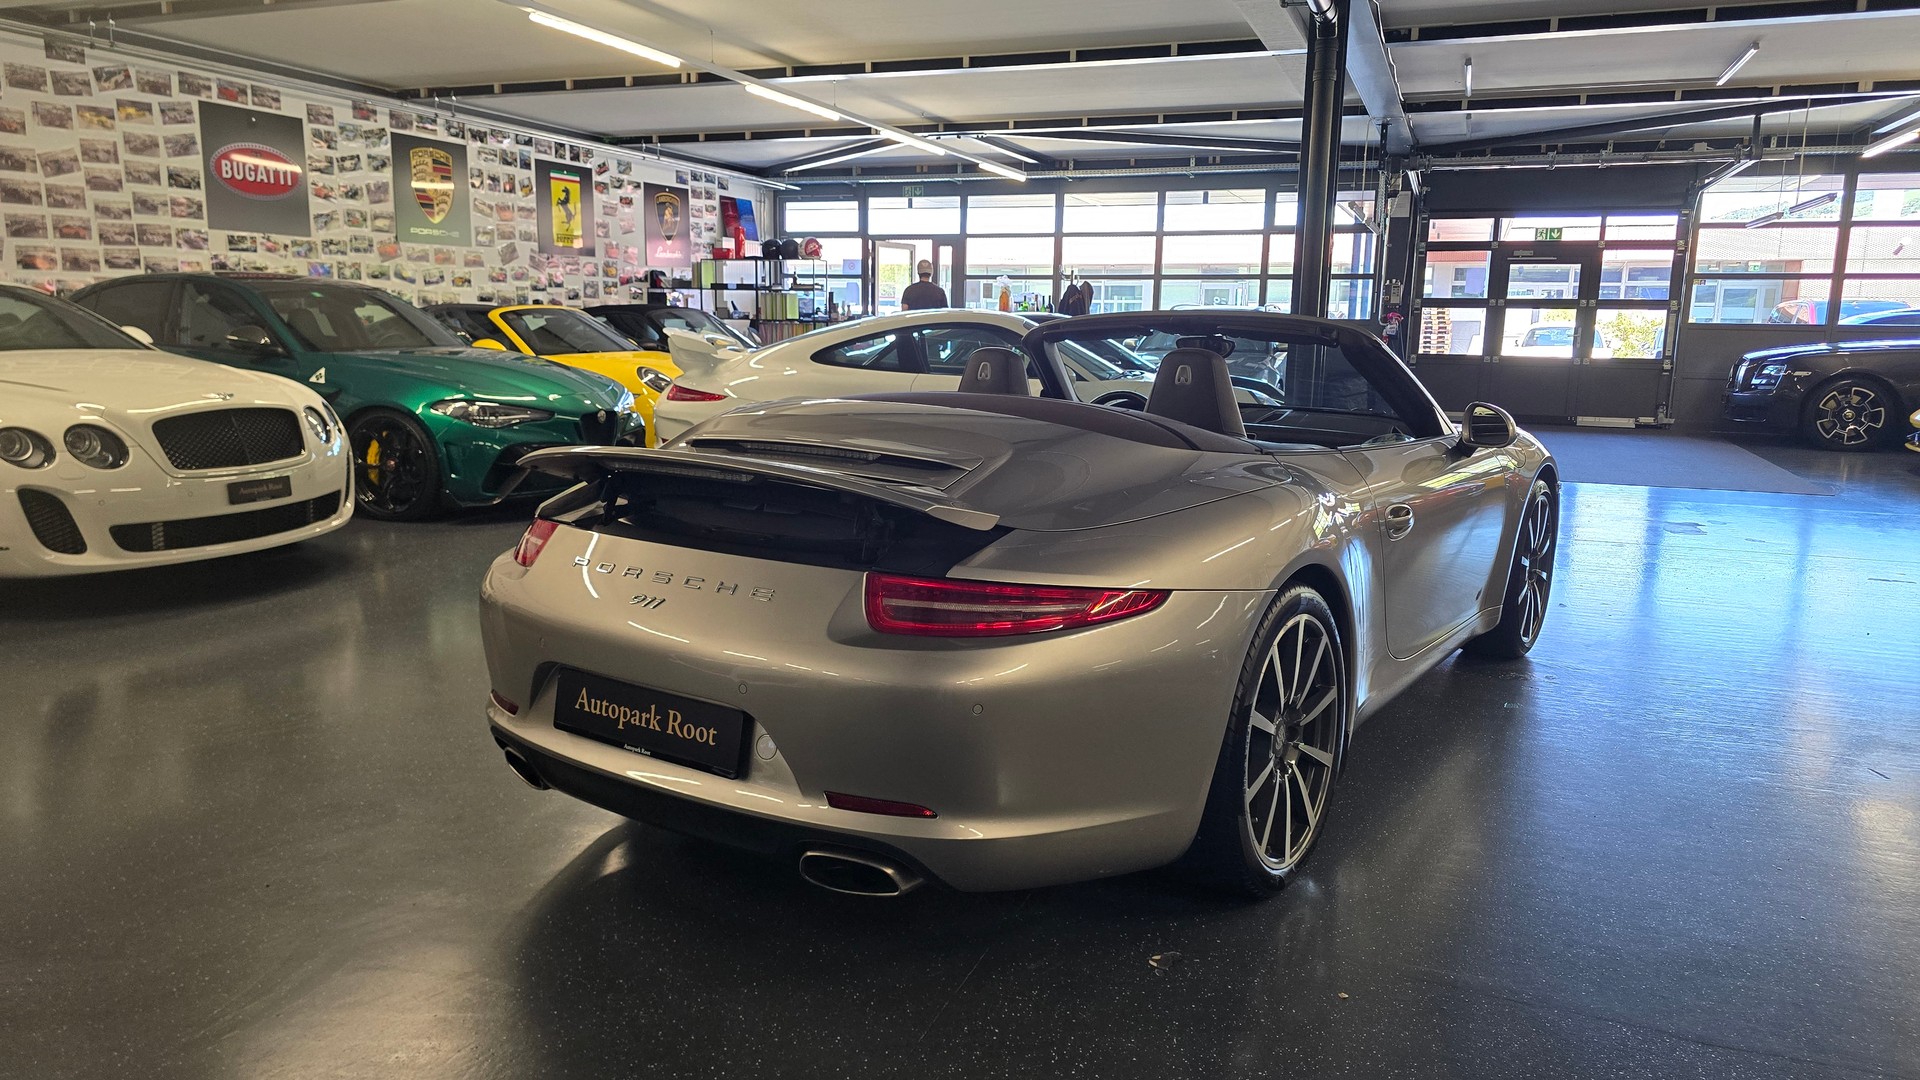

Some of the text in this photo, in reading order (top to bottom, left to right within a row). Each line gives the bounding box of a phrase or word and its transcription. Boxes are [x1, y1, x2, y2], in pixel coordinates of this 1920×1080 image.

[412, 150, 451, 162] PORSCHE
[221, 159, 292, 186] BUGATTI
[572, 555, 776, 602] PORSCHE
[629, 593, 666, 609] 911
[574, 687, 718, 746] Autopark Root
